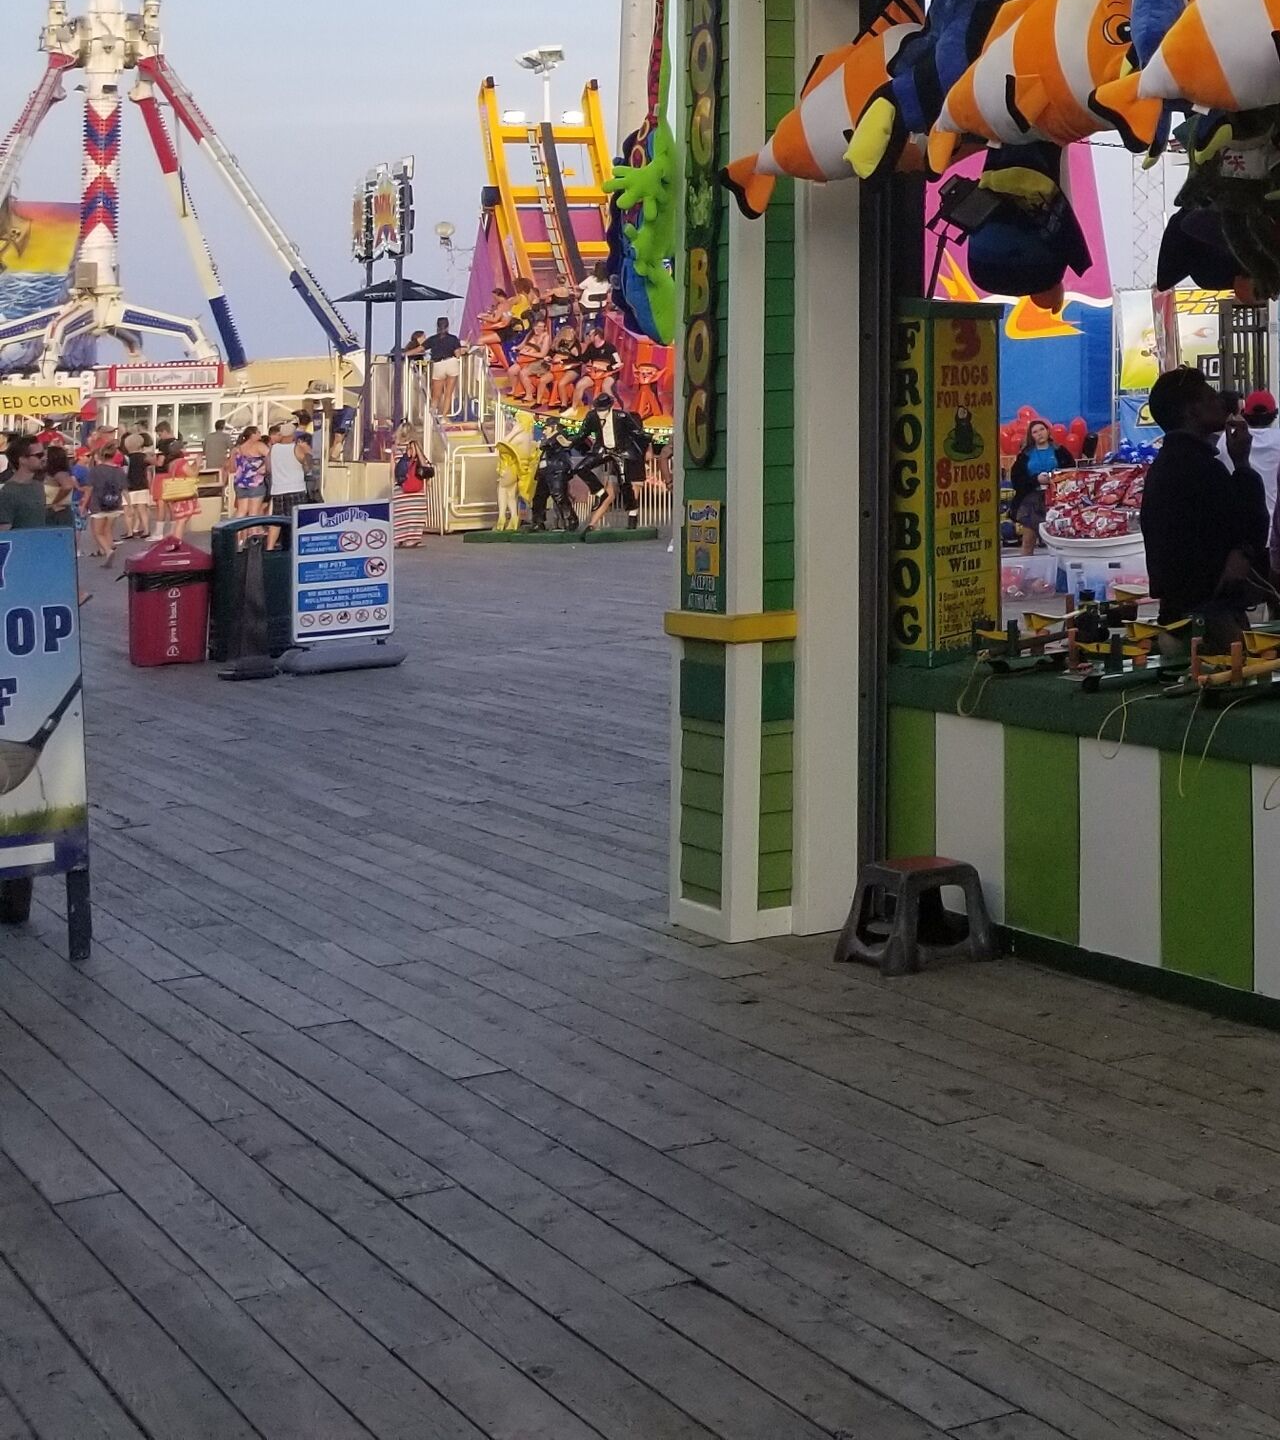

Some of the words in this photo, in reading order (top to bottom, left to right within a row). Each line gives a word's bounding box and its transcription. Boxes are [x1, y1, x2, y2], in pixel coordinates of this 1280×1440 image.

[687, 247, 710, 459] BOG
[951, 319, 981, 362] 3
[941, 365, 989, 387] FROGS
[28, 393, 74, 408] CORN
[892, 321, 922, 498] FROG
[936, 391, 958, 408] FOR
[936, 457, 951, 490] 8
[952, 462, 990, 483] FROGS
[936, 490, 959, 509] FOR
[950, 510, 980, 526] RULES
[949, 555, 981, 573] Wins
[895, 512, 922, 645] BOG
[5, 605, 72, 656] OP
